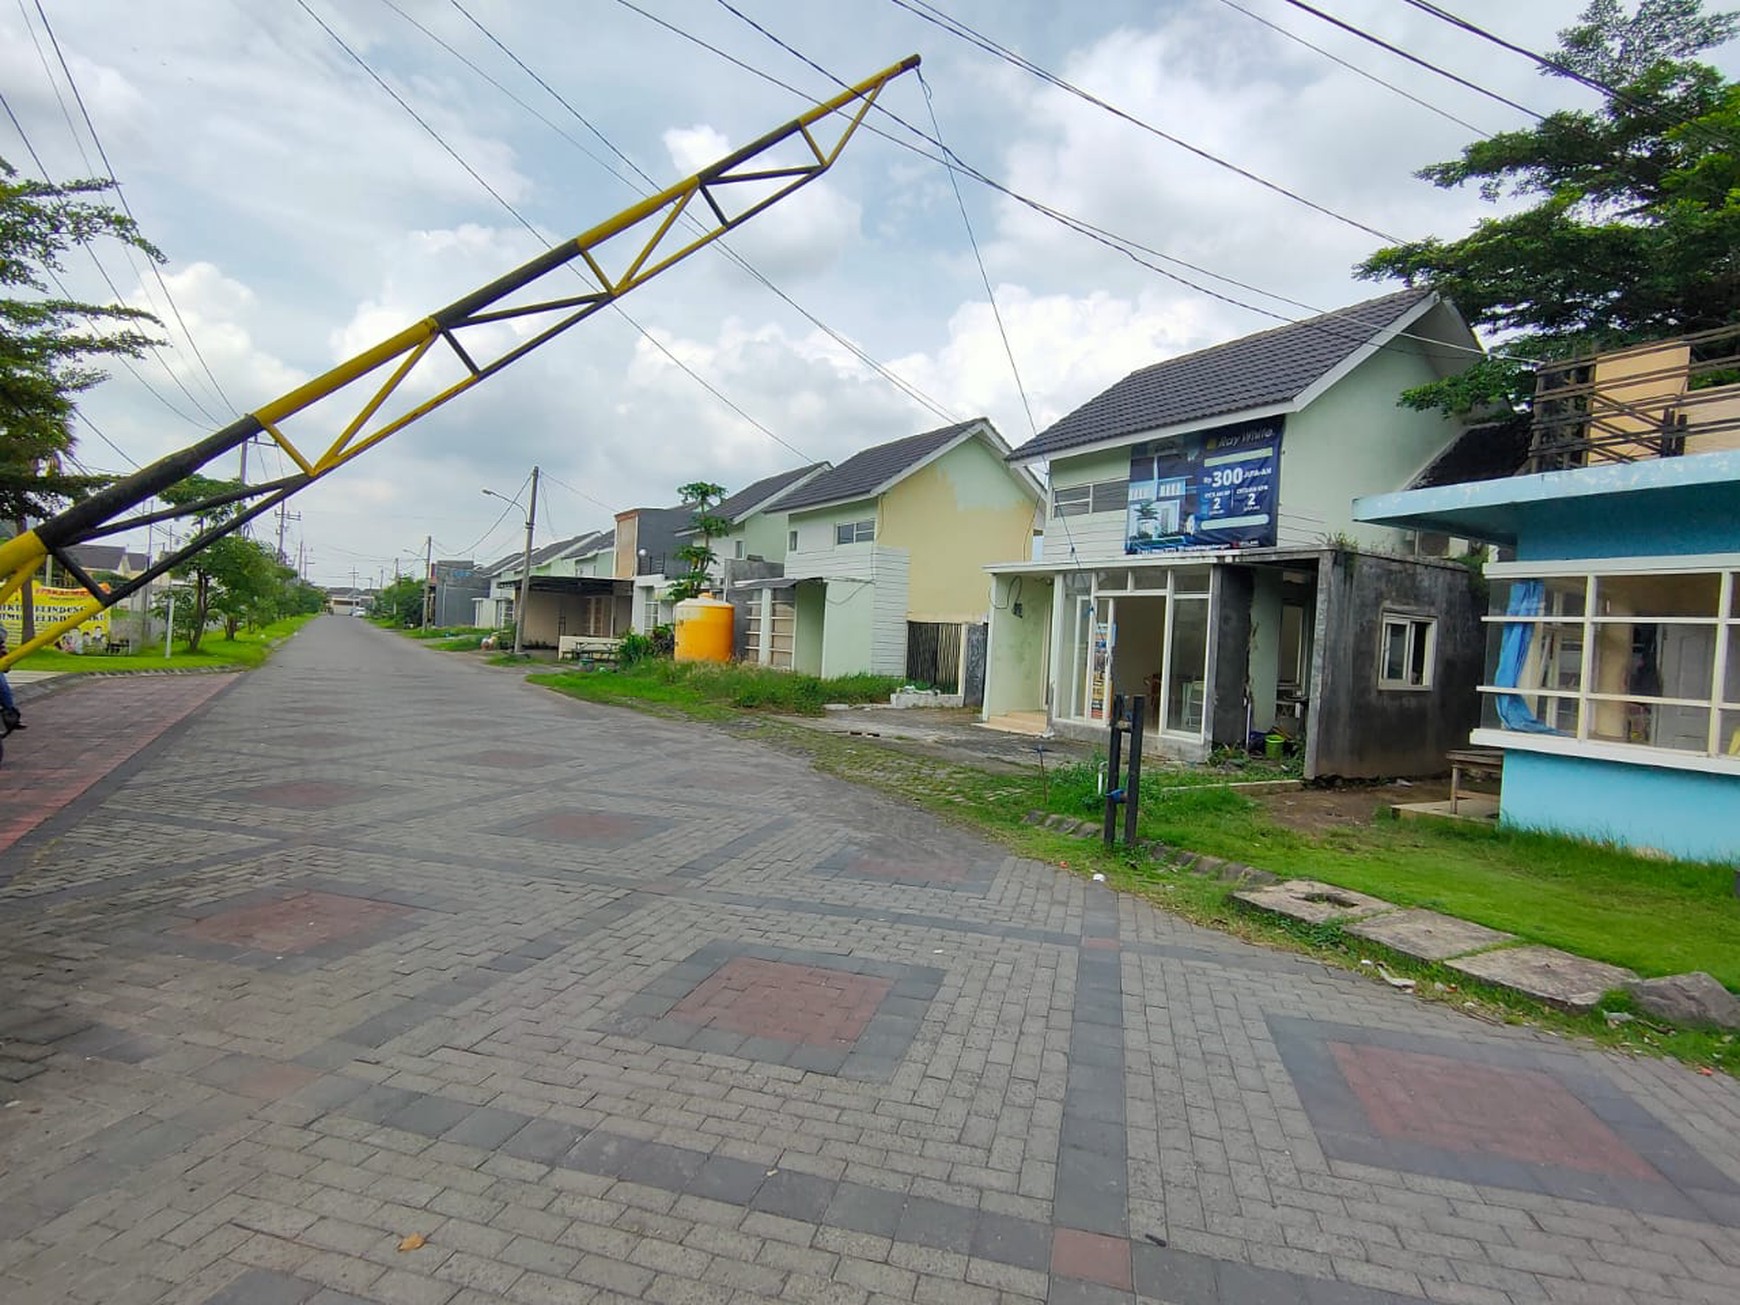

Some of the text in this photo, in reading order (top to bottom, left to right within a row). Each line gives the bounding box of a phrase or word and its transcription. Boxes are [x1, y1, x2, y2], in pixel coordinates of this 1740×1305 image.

[1212, 467, 1243, 488] 300
[1213, 498, 1221, 510] 2
[1247, 493, 1256, 506] 2
